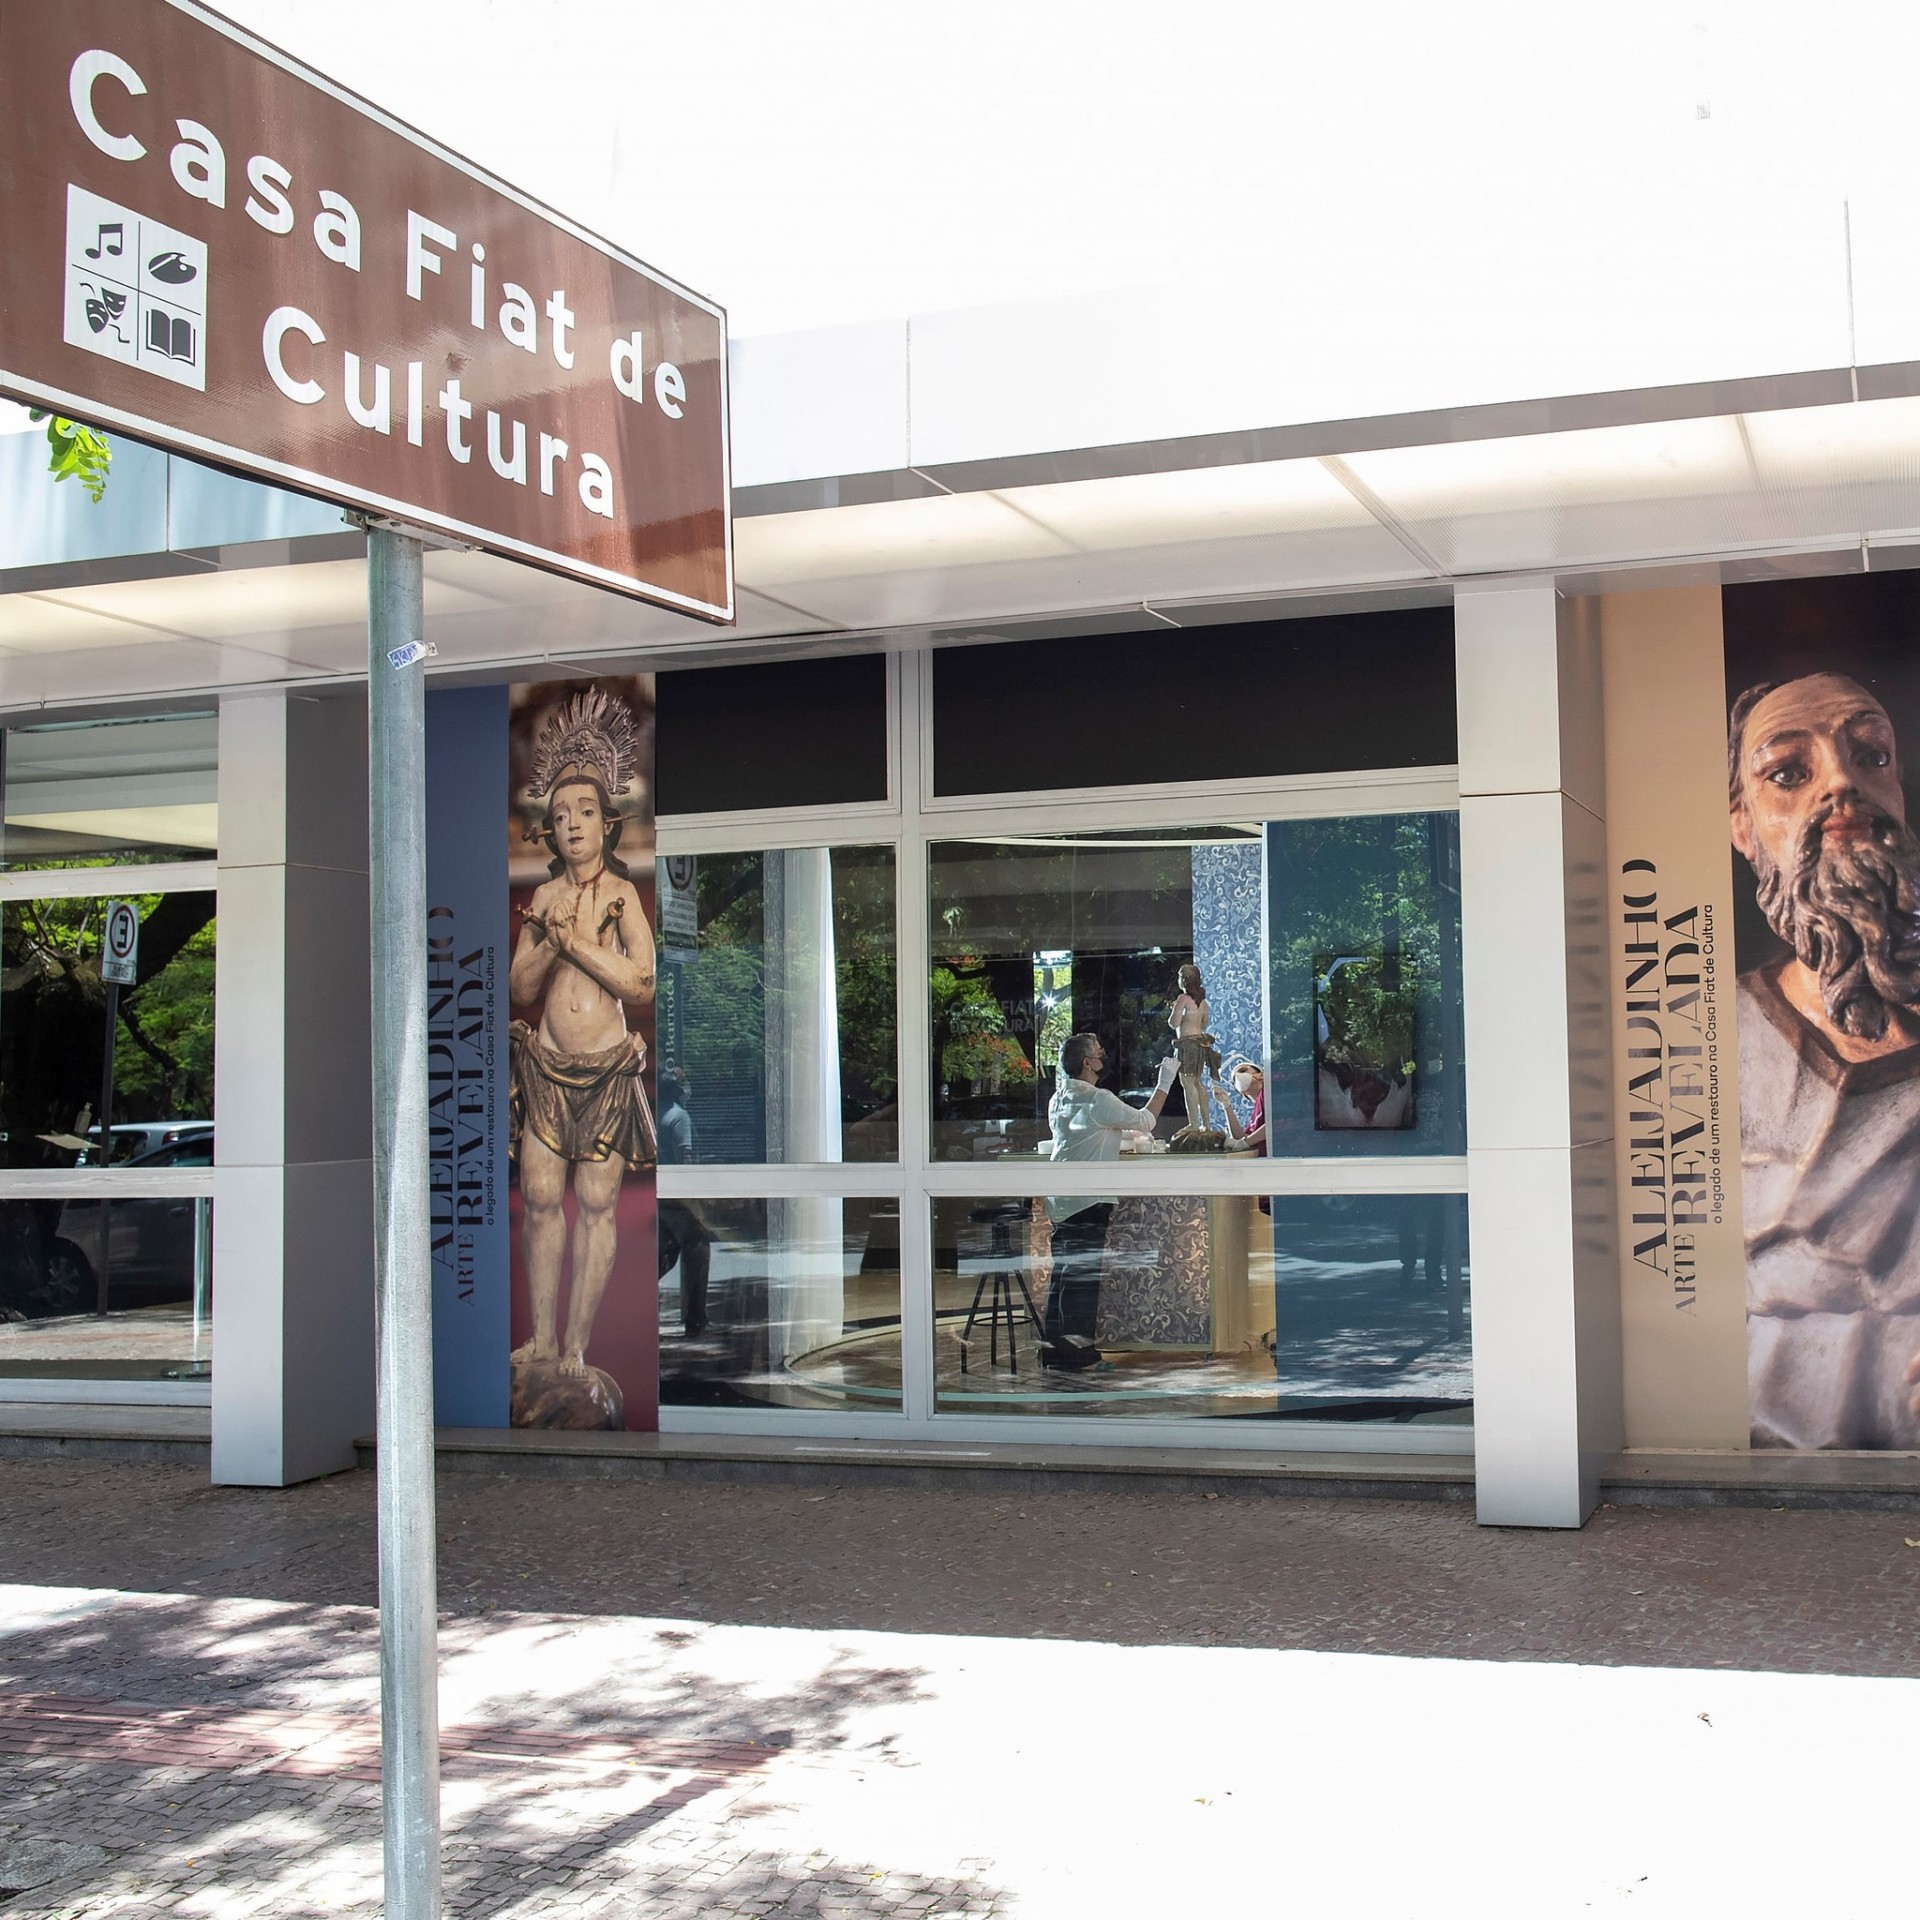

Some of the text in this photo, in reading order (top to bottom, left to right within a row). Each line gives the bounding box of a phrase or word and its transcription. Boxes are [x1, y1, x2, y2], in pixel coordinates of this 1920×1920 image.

[69, 49, 687, 420] Casa Fiat de
[262, 306, 614, 519] Cultura
[485, 946, 495, 991] Cultura
[485, 992, 494, 1008] de
[485, 1010, 494, 1033] Fiat
[665, 972, 676, 1072] O Barroco
[485, 1035, 495, 1066] Casa
[1622, 859, 1669, 1278] ALEIJADINHO
[1702, 904, 1724, 1224] o legado de um restauro na Casa Fiat de Cultura
[428, 906, 455, 1271] ALEIJADINHO
[486, 1069, 494, 1084] na
[457, 947, 484, 1307] ARTE REVELADA
[485, 1086, 495, 1135] restauro
[1664, 905, 1707, 1317] ARTE REVELADA
[485, 1159, 494, 1173] de
[486, 1138, 494, 1156] um
[485, 1176, 496, 1215] legado
